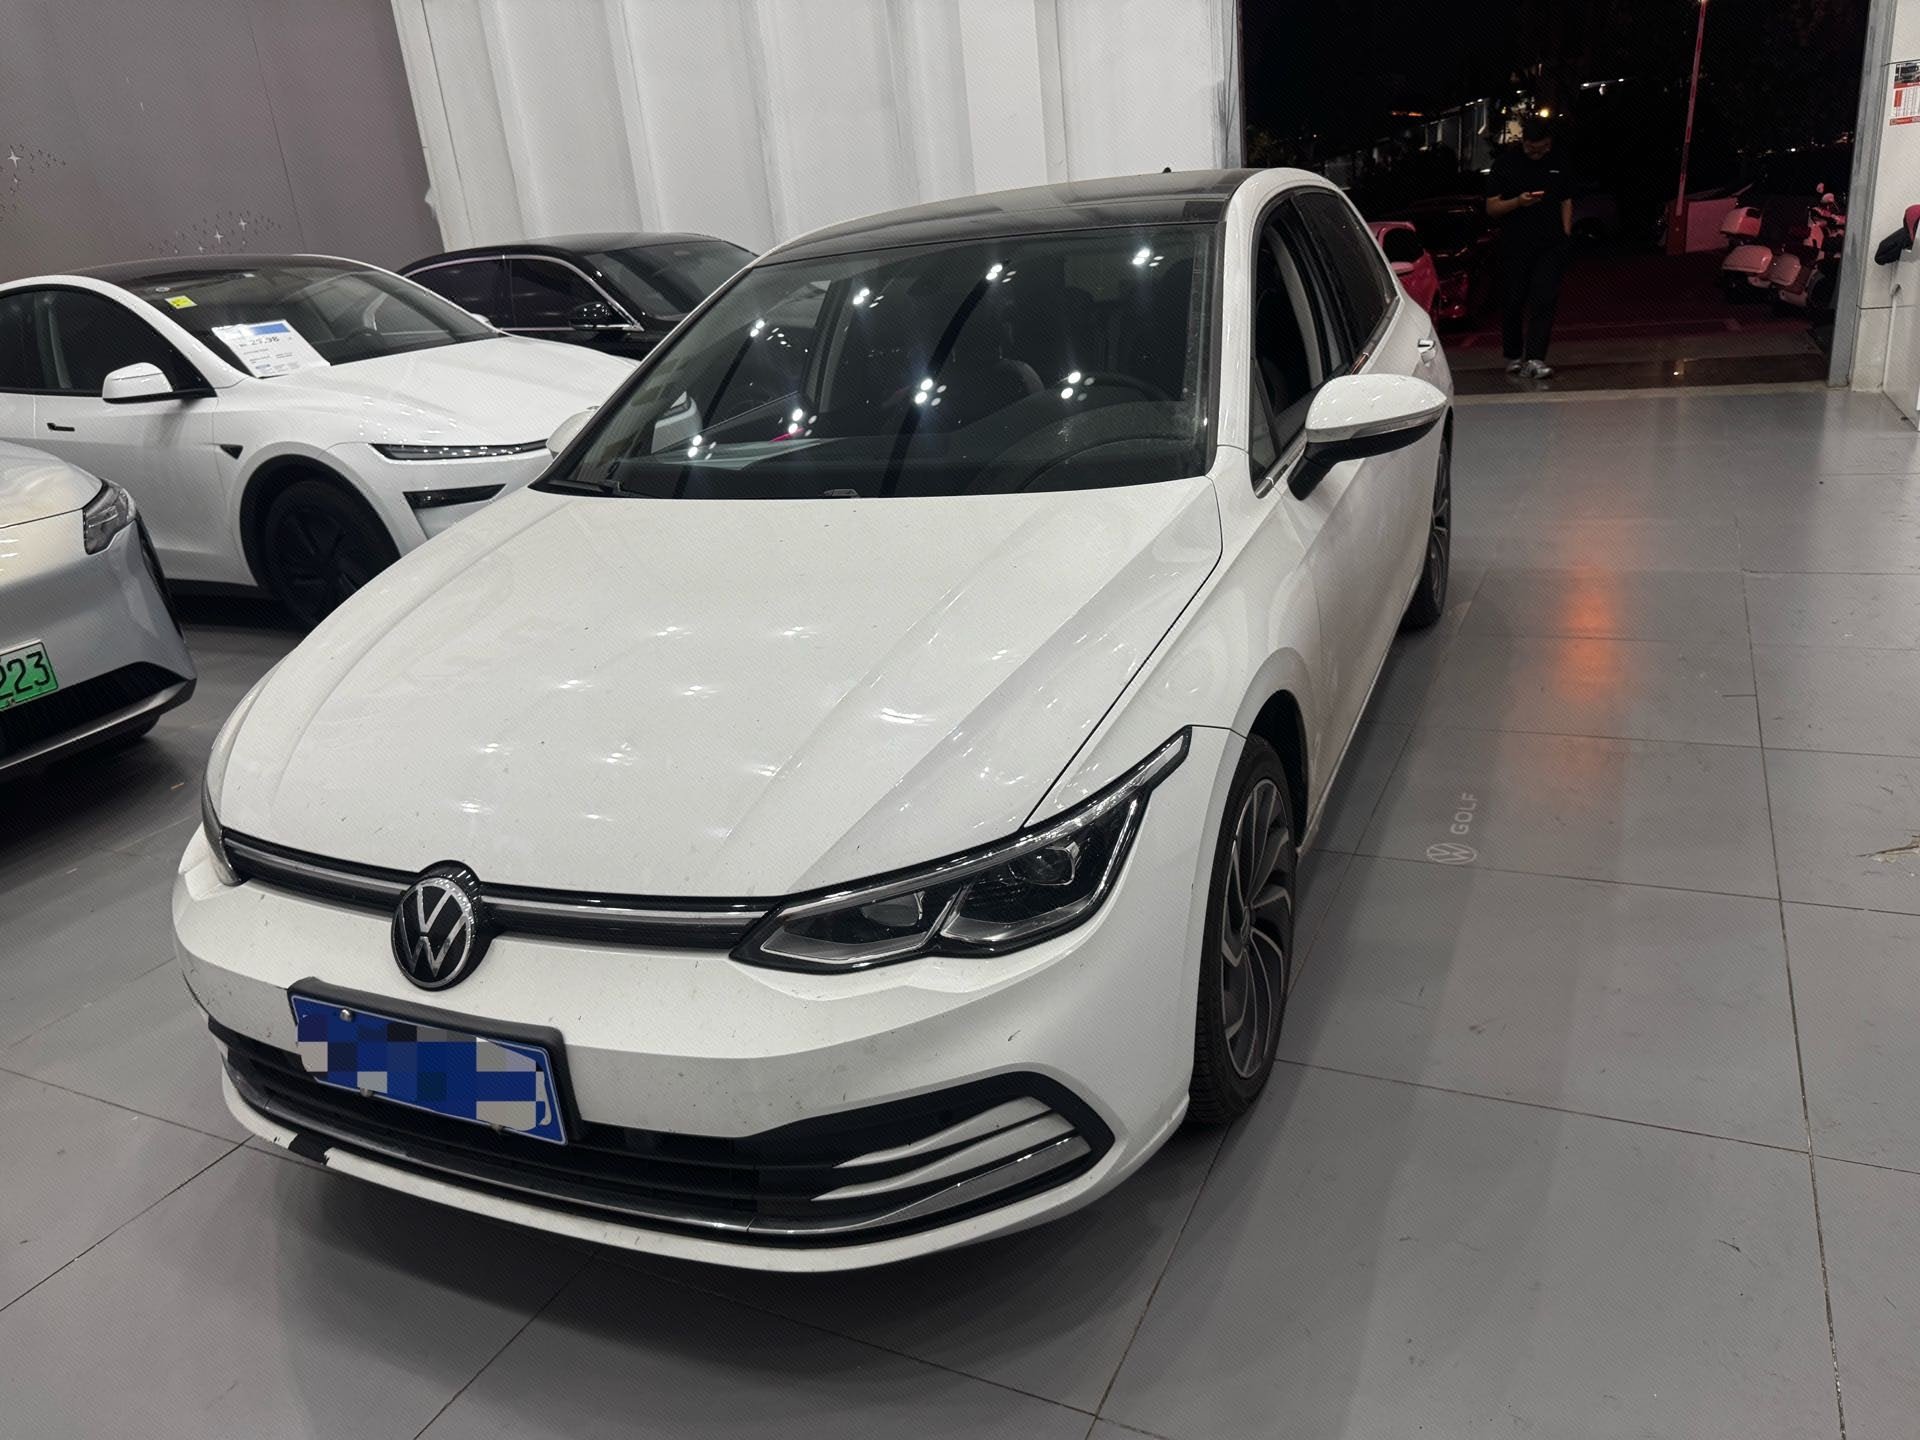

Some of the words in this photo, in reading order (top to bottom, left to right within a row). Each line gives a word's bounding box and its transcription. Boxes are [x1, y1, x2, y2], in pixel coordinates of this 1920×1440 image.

[0, 650, 50, 699] 23
[1450, 792, 1478, 835] GOLF
[392, 877, 474, 988] VW
